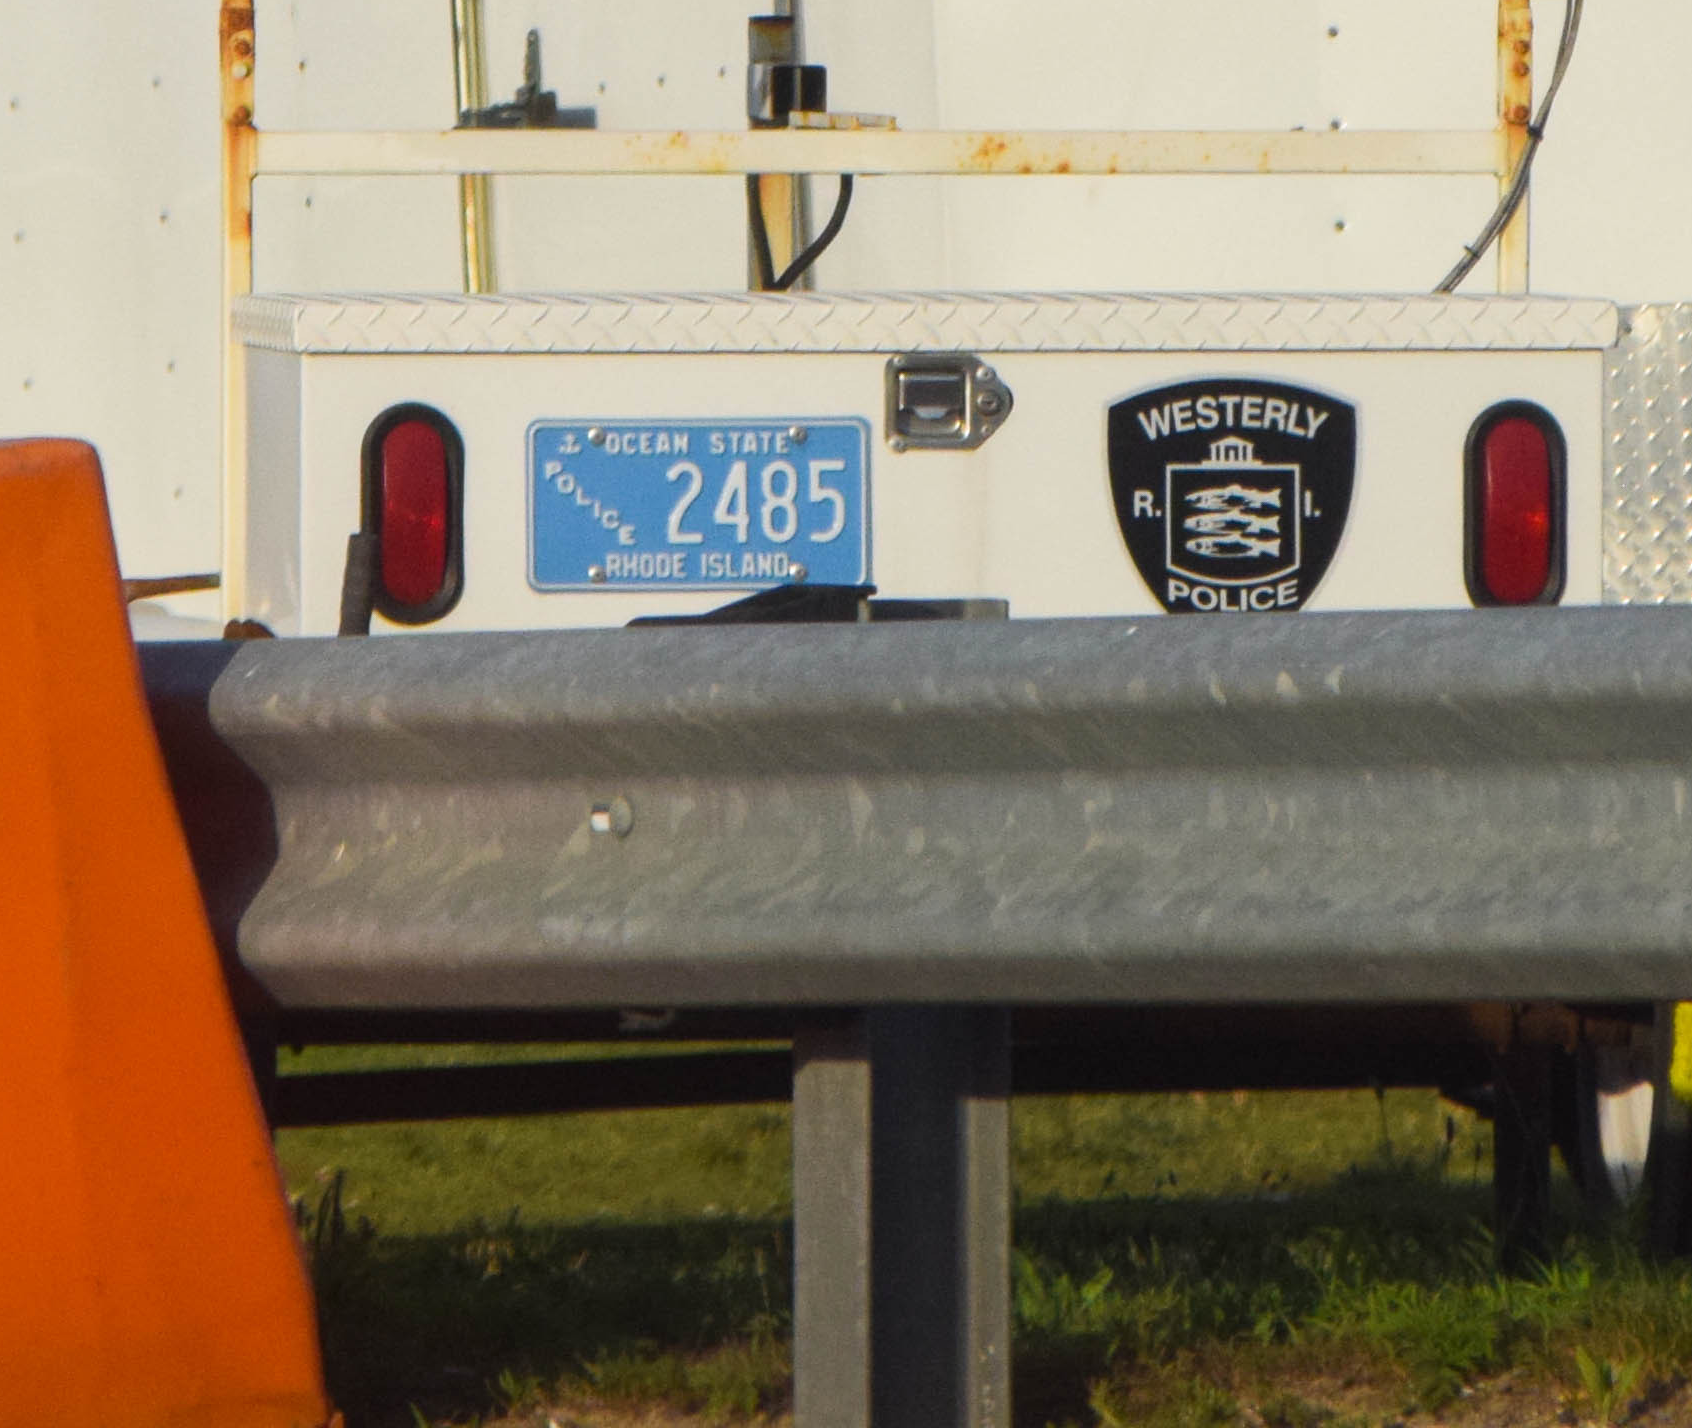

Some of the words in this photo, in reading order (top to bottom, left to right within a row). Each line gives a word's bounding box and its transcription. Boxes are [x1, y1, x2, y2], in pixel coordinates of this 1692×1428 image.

[1136, 395, 1330, 442] WESTERLY
[605, 431, 690, 455] OCEAN
[710, 432, 790, 455] STATE
[545, 460, 636, 546] POLICE
[665, 459, 847, 545] 2485
[1132, 489, 1162, 518] R.
[1303, 489, 1321, 518] I.
[605, 552, 688, 579] RHODE
[701, 552, 789, 579] ISLAND
[1167, 576, 1299, 612] POLICE
